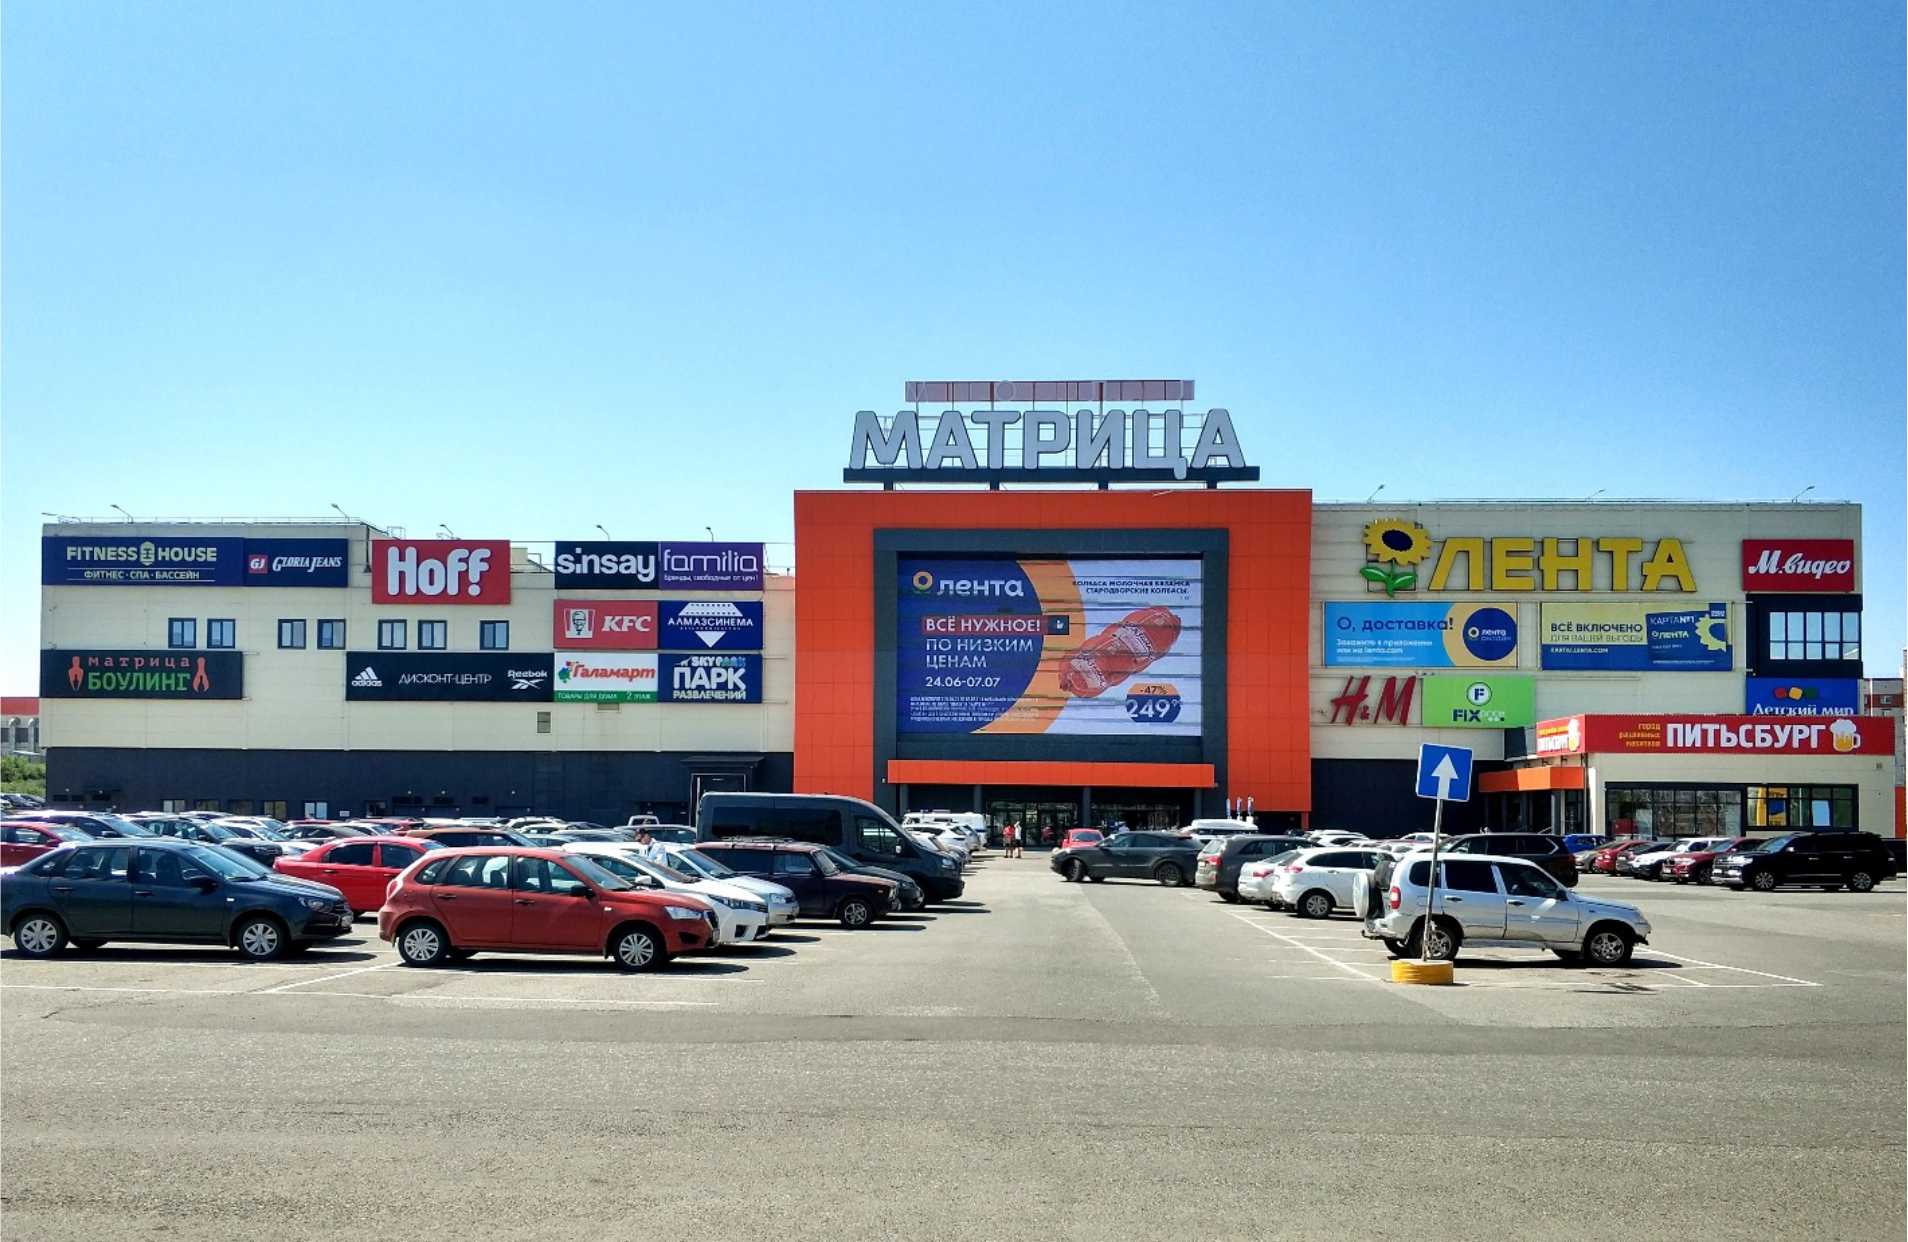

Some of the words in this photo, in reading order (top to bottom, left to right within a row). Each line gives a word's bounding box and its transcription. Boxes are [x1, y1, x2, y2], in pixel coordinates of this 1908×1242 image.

[849, 409, 1246, 480] МАТРИЦА
[66, 547, 138, 561] FITNESS
[158, 547, 217, 562] HOUSE
[664, 549, 758, 572] familia
[250, 558, 266, 569] GJ
[558, 548, 656, 583] sinsay
[1428, 537, 1697, 592] ЛЕНТА
[1748, 549, 1851, 579] М.видео
[84, 570, 124, 579] ФИТНЕС
[130, 571, 149, 579] СПА
[156, 570, 200, 580] БАССЕЙН
[937, 578, 1025, 598] лента
[601, 616, 652, 631] KFC
[667, 618, 754, 627] АЛМАЗСИНЕМА
[926, 618, 956, 632] ВСЁ
[961, 619, 1041, 632] НУЖНОЕ!
[1361, 618, 1454, 631] доставка!
[1551, 622, 1573, 632] ВСЁ
[1576, 624, 1643, 633] ВКЛЮЧЕНО
[926, 639, 952, 651] ПО
[957, 639, 1034, 652] НИЗКИМ
[88, 656, 190, 667] матрица
[926, 655, 987, 669] ЦЕНАМ
[399, 673, 492, 684] ДИСКОНТ-ЦЕНТР
[508, 670, 548, 679] Reebok
[573, 665, 655, 682] Галамарт
[673, 667, 746, 690] ПАРК
[87, 672, 191, 691] БОУЛИНГ
[926, 676, 1001, 687] 24.06-07.07
[673, 690, 746, 699] РАЗВЛЕЧЕНИЙ
[1330, 676, 1417, 727] H&M
[1126, 699, 1171, 718] 249
[1666, 723, 1826, 748] ПИТЬСБУРГ
